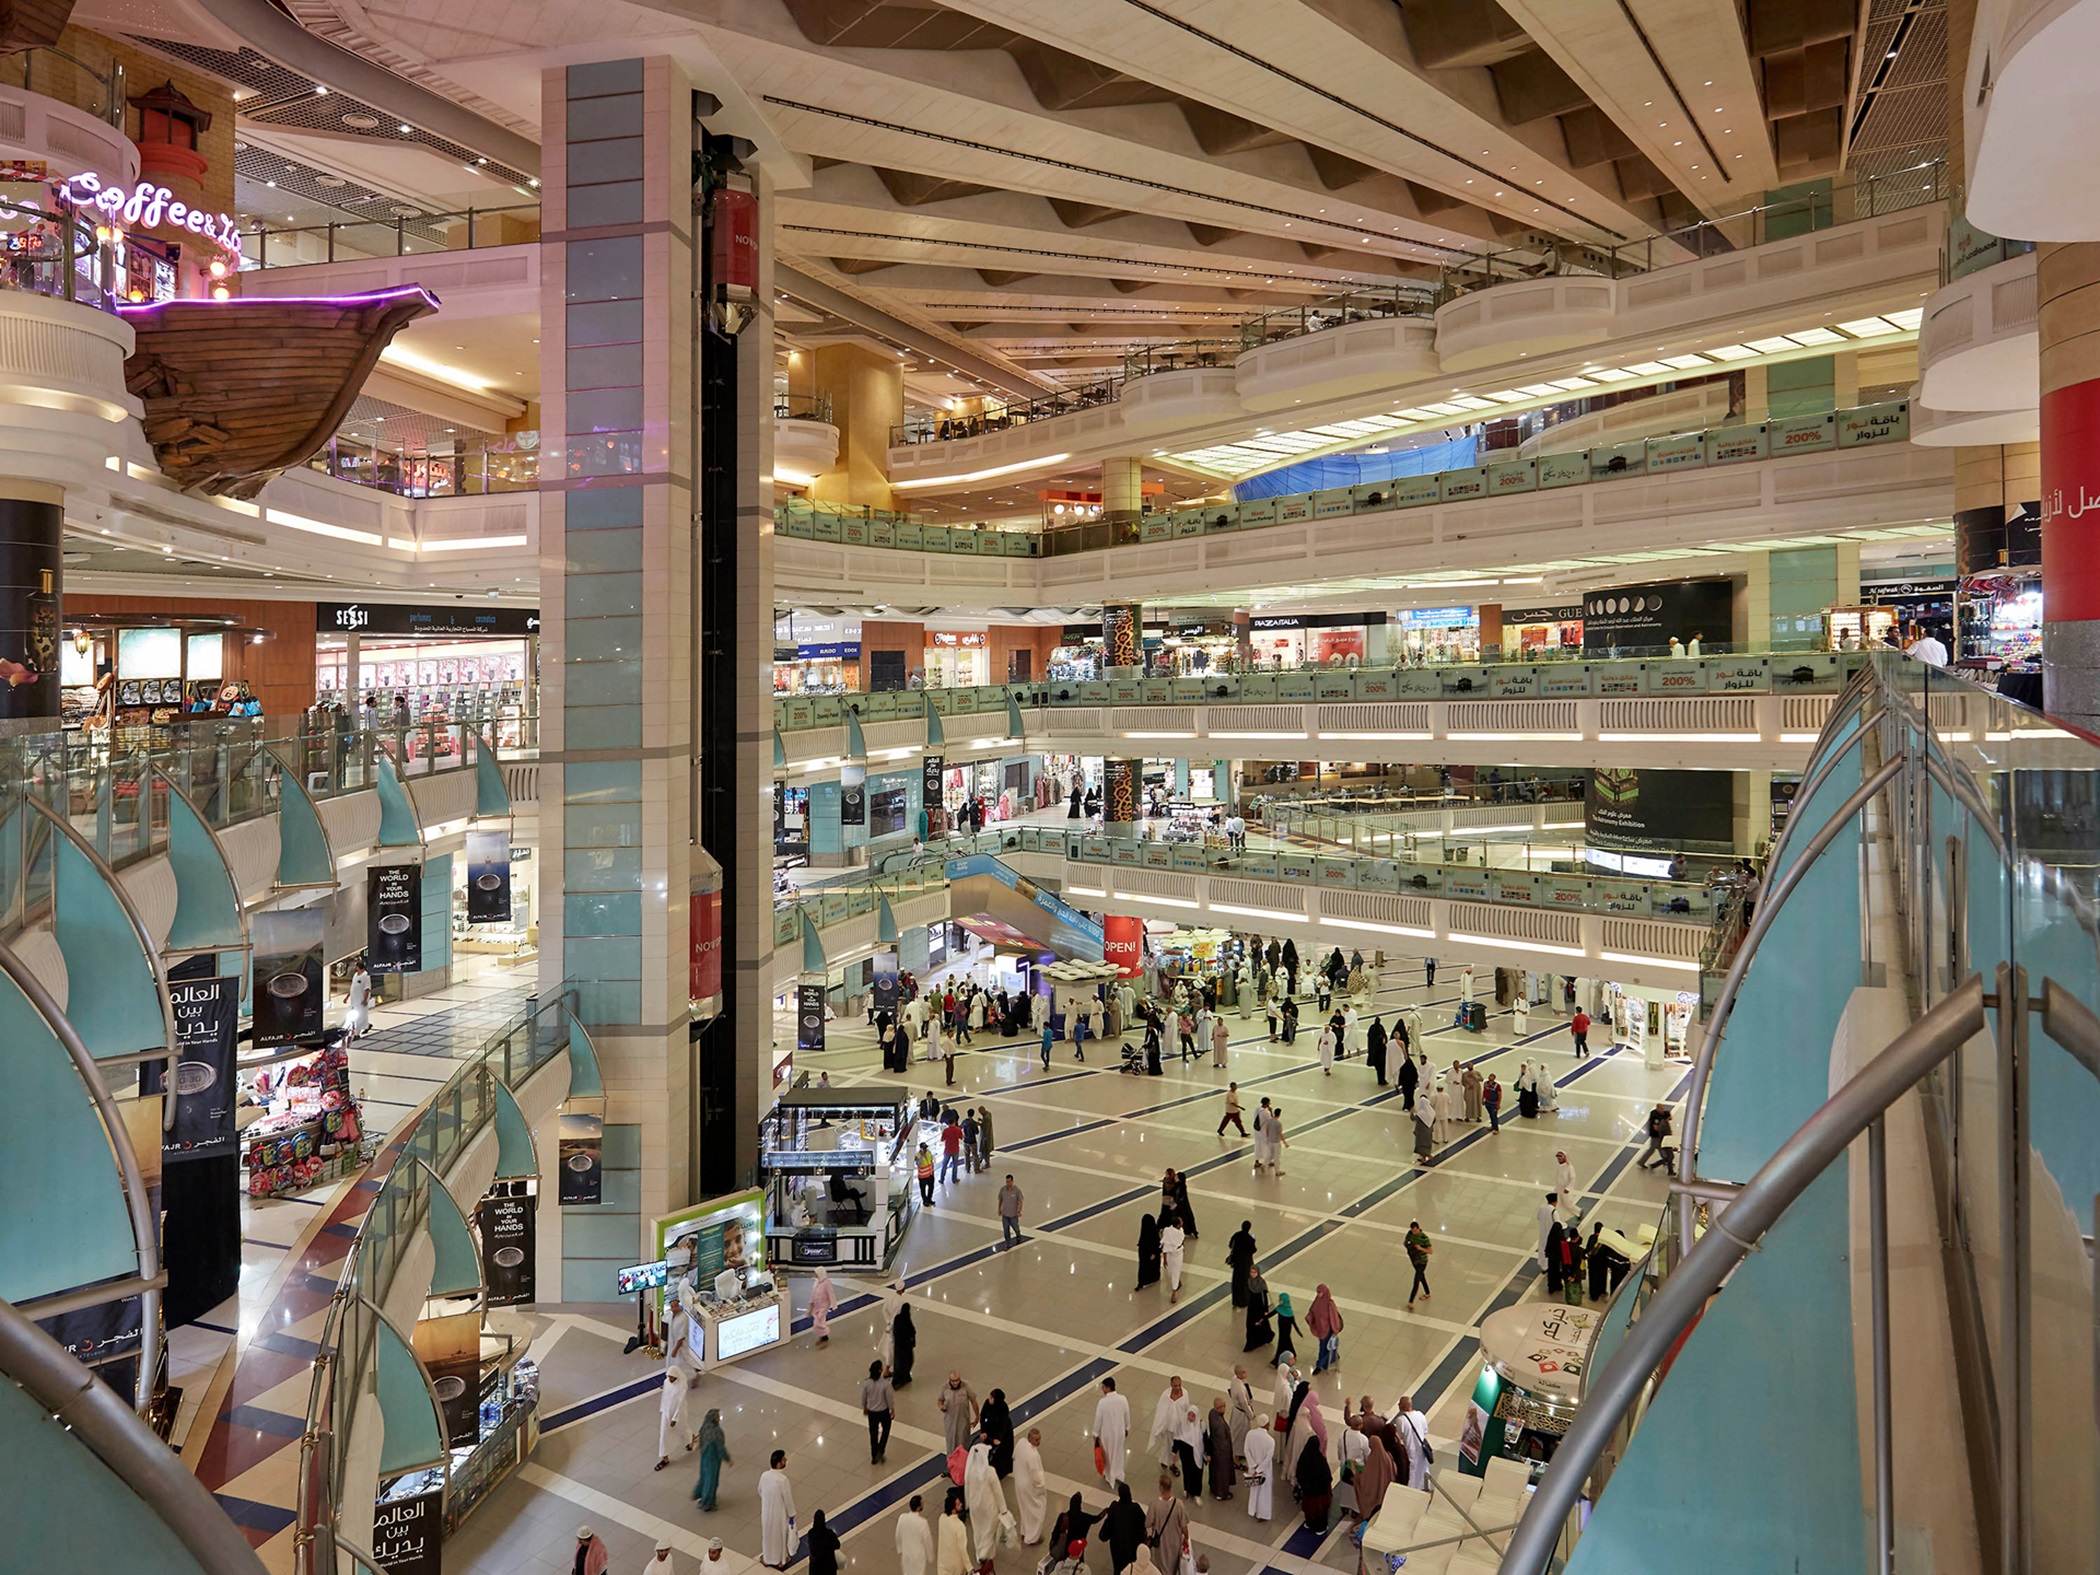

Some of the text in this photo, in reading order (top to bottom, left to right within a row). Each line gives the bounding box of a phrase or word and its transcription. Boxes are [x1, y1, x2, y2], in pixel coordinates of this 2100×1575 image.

[1846, 414, 1900, 432] باقة نور
[1785, 430, 1822, 444] 200%
[1856, 427, 1889, 441] للزوار
[1499, 477, 1525, 486] 200%
[1716, 668, 1763, 680] باقة نور
[1512, 677, 1532, 685] باقة
[1662, 677, 1696, 686] 200%
[1724, 680, 1753, 690] للزوار
[1365, 685, 1387, 693] 200%
[1619, 820, 1645, 828] Exhibition
[379, 874, 409, 882] WORLD
[1325, 870, 1346, 878] 200%
[379, 891, 409, 899] HANDS
[1555, 893, 1582, 902] 200%
[1620, 893, 1642, 902] باقة
[1104, 941, 1136, 952] OPEN!
[178, 1006, 203, 1018] بين
[260, 1034, 284, 1042] ALFAJR
[194, 1136, 225, 1149] الفجر
[494, 1207, 524, 1215] WORLD
[494, 1224, 524, 1232] HANDS
[373, 1501, 425, 1528] العالم
[386, 1525, 409, 1539] بين
[372, 1536, 424, 1560] يديك
